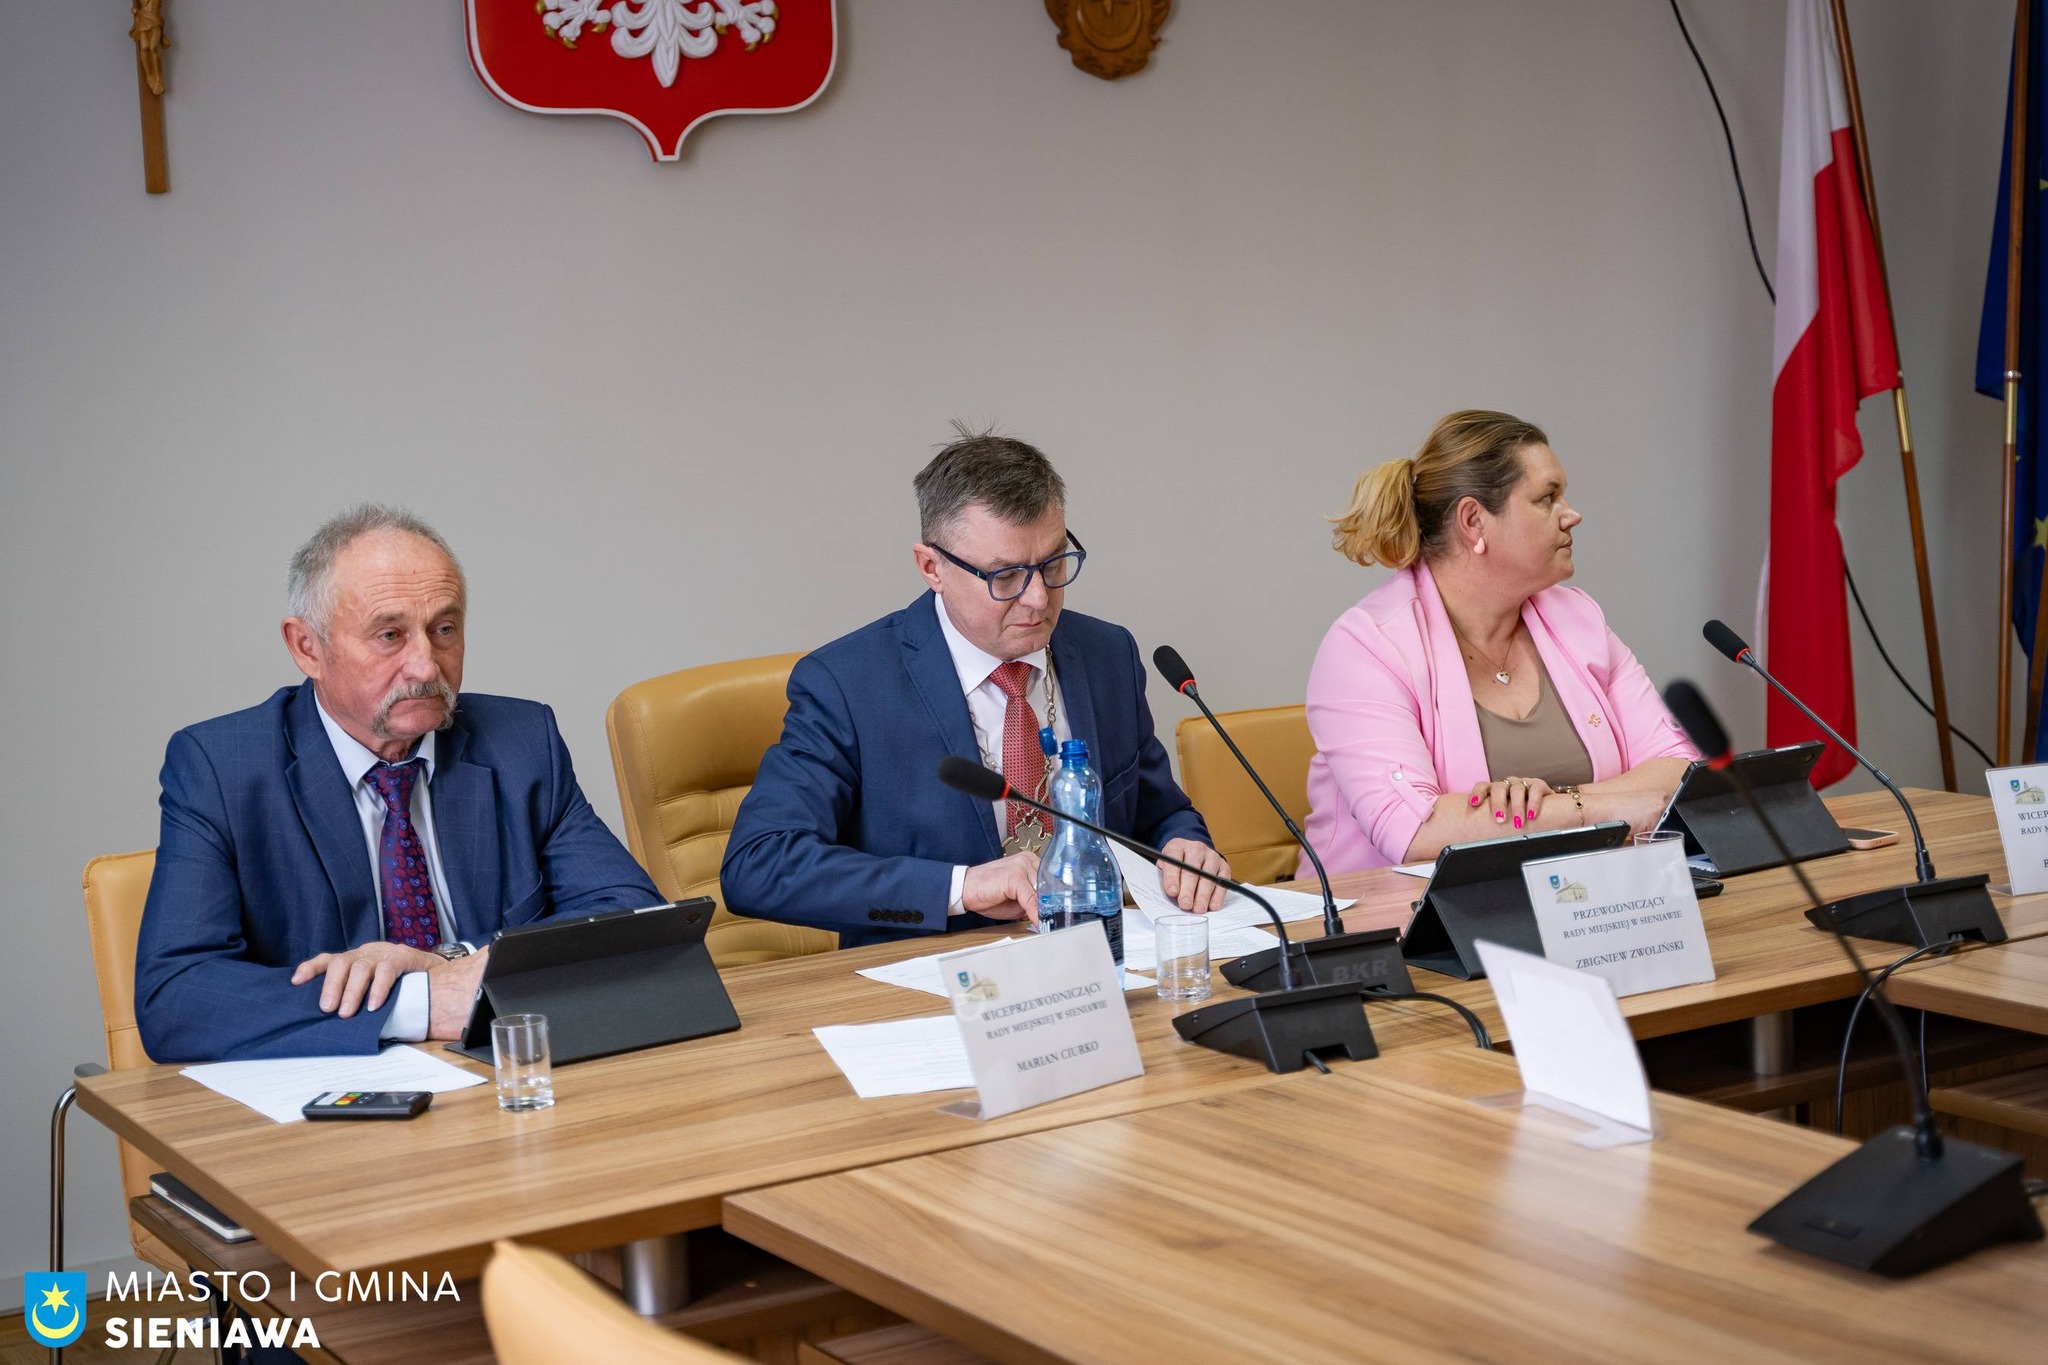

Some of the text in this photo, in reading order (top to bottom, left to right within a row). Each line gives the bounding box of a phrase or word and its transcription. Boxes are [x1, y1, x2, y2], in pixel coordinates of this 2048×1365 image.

[2020, 826, 2043, 835] RADY
[1573, 896, 1666, 920] PRZEWODNICZĄCY
[1563, 910, 1683, 939] RADY MIEJSKIEJ W SIENIAWIE
[1575, 940, 1685, 969] ZBIGNIEW ZWOLIŃSKI
[1333, 959, 1389, 982] BKR
[981, 982, 1103, 1022] WICEPRZEWODNICZĄCY
[986, 1000, 1109, 1040] RADY MIEJSKIEJ W SIENIAWIE
[1016, 1041, 1099, 1073] MARIAN CIURKO
